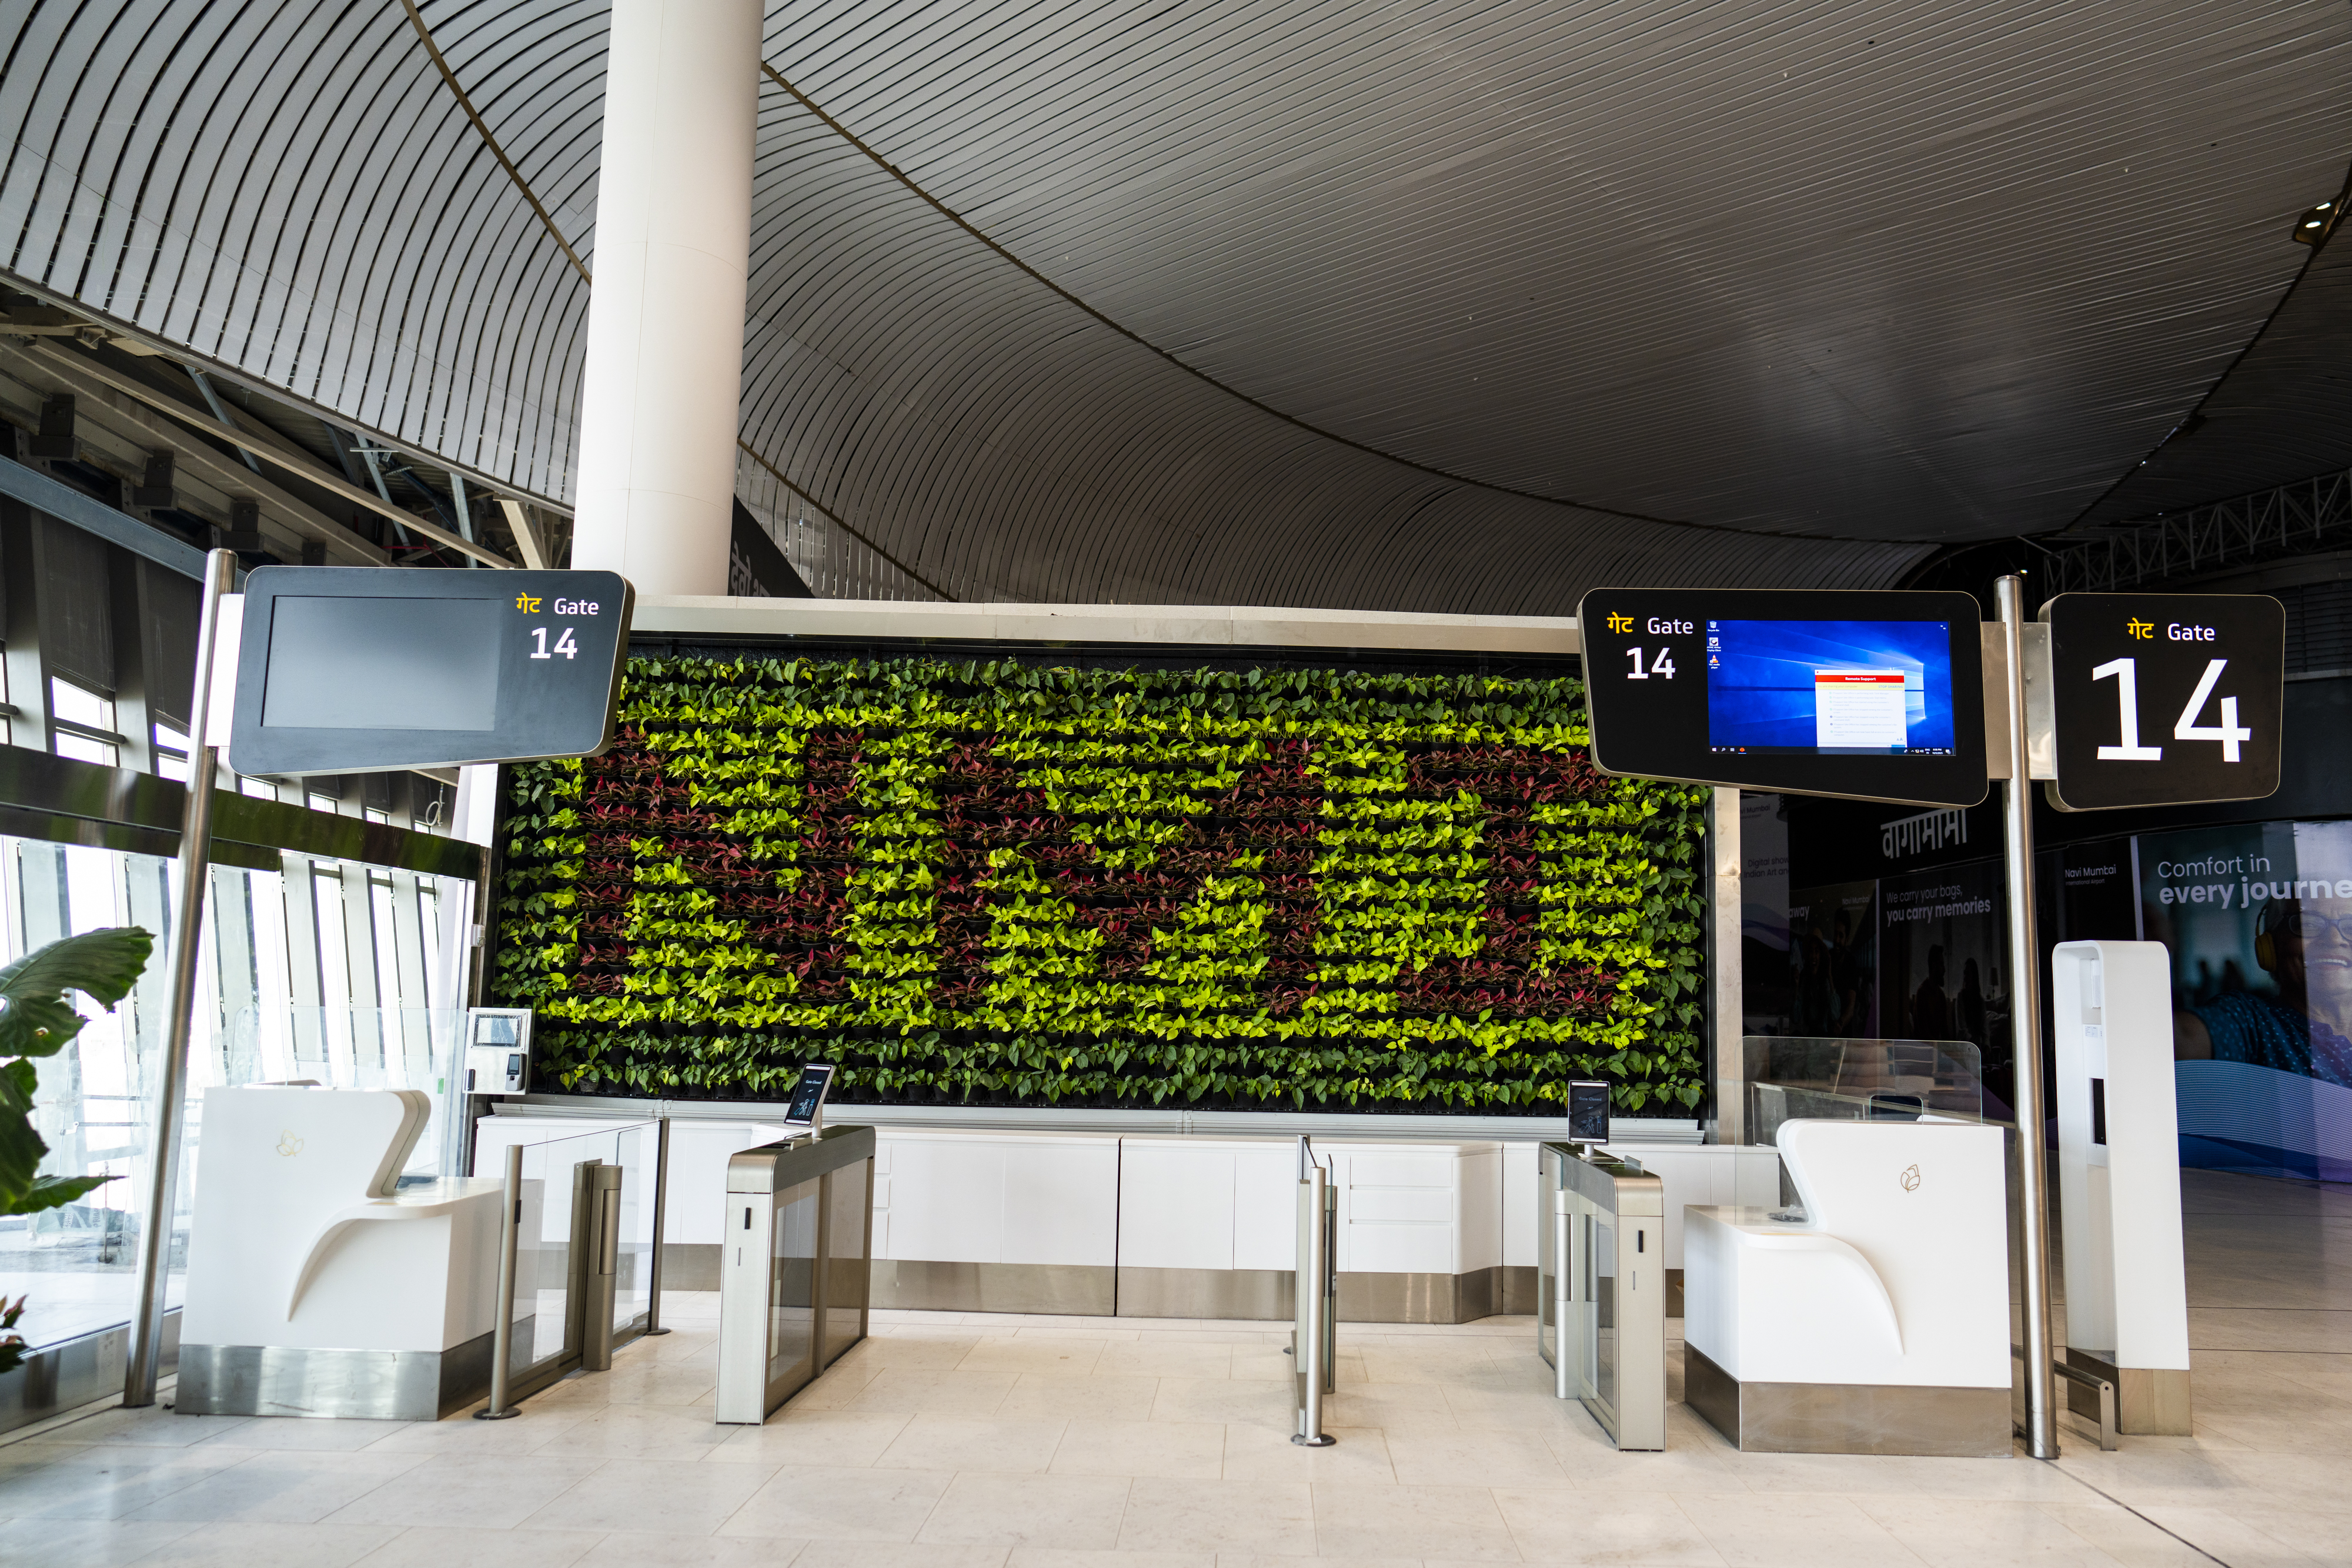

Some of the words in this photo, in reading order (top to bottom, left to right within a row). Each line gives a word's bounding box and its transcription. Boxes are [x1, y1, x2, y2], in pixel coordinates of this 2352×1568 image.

[516, 591, 543, 614] गेट
[554, 598, 599, 615] Gate
[1606, 611, 1634, 634] गेट
[1648, 617, 1693, 634] Gate
[2127, 617, 2154, 640] गेट
[2168, 623, 2215, 641] Gate
[530, 627, 578, 659] 14
[1626, 647, 1676, 679] 14
[2093, 658, 2251, 763] 14
[1746, 804, 1770, 814] Mumbai
[1880, 808, 1967, 859] वागामामा
[1744, 870, 1765, 878] Indian
[1748, 858, 1770, 869] Digital
[2064, 867, 2082, 878] Navi
[2083, 864, 2116, 877] Mumbai
[2157, 856, 2244, 878] Comfort
[2249, 854, 2270, 872] in
[1852, 895, 1870, 904] Mumbai
[1886, 892, 1898, 904] We
[1899, 890, 1919, 904] carry
[1921, 888, 1937, 903] your
[1940, 884, 1963, 900] bags,
[2159, 884, 2235, 910] every
[2241, 876, 2352, 909] journe
[1789, 905, 1810, 921] away
[1886, 908, 1905, 927] you
[1906, 906, 1933, 924] carry
[1935, 895, 1991, 917] memories
